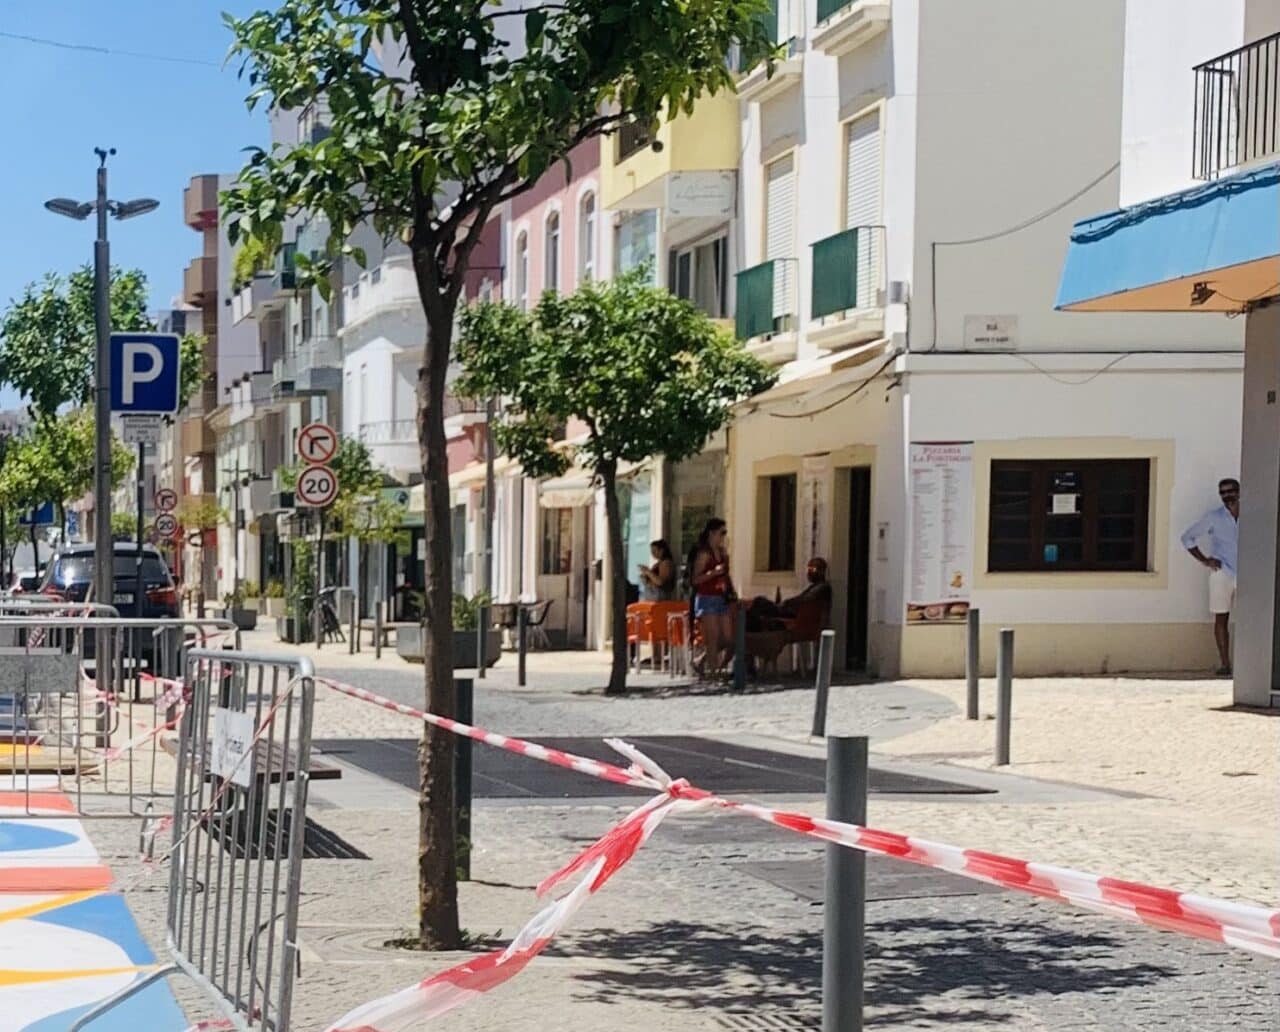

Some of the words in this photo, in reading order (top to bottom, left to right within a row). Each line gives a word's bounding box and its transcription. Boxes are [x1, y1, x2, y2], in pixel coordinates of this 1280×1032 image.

[122, 342, 164, 405] P
[305, 478, 330, 494] 20
[159, 520, 174, 530] 20
